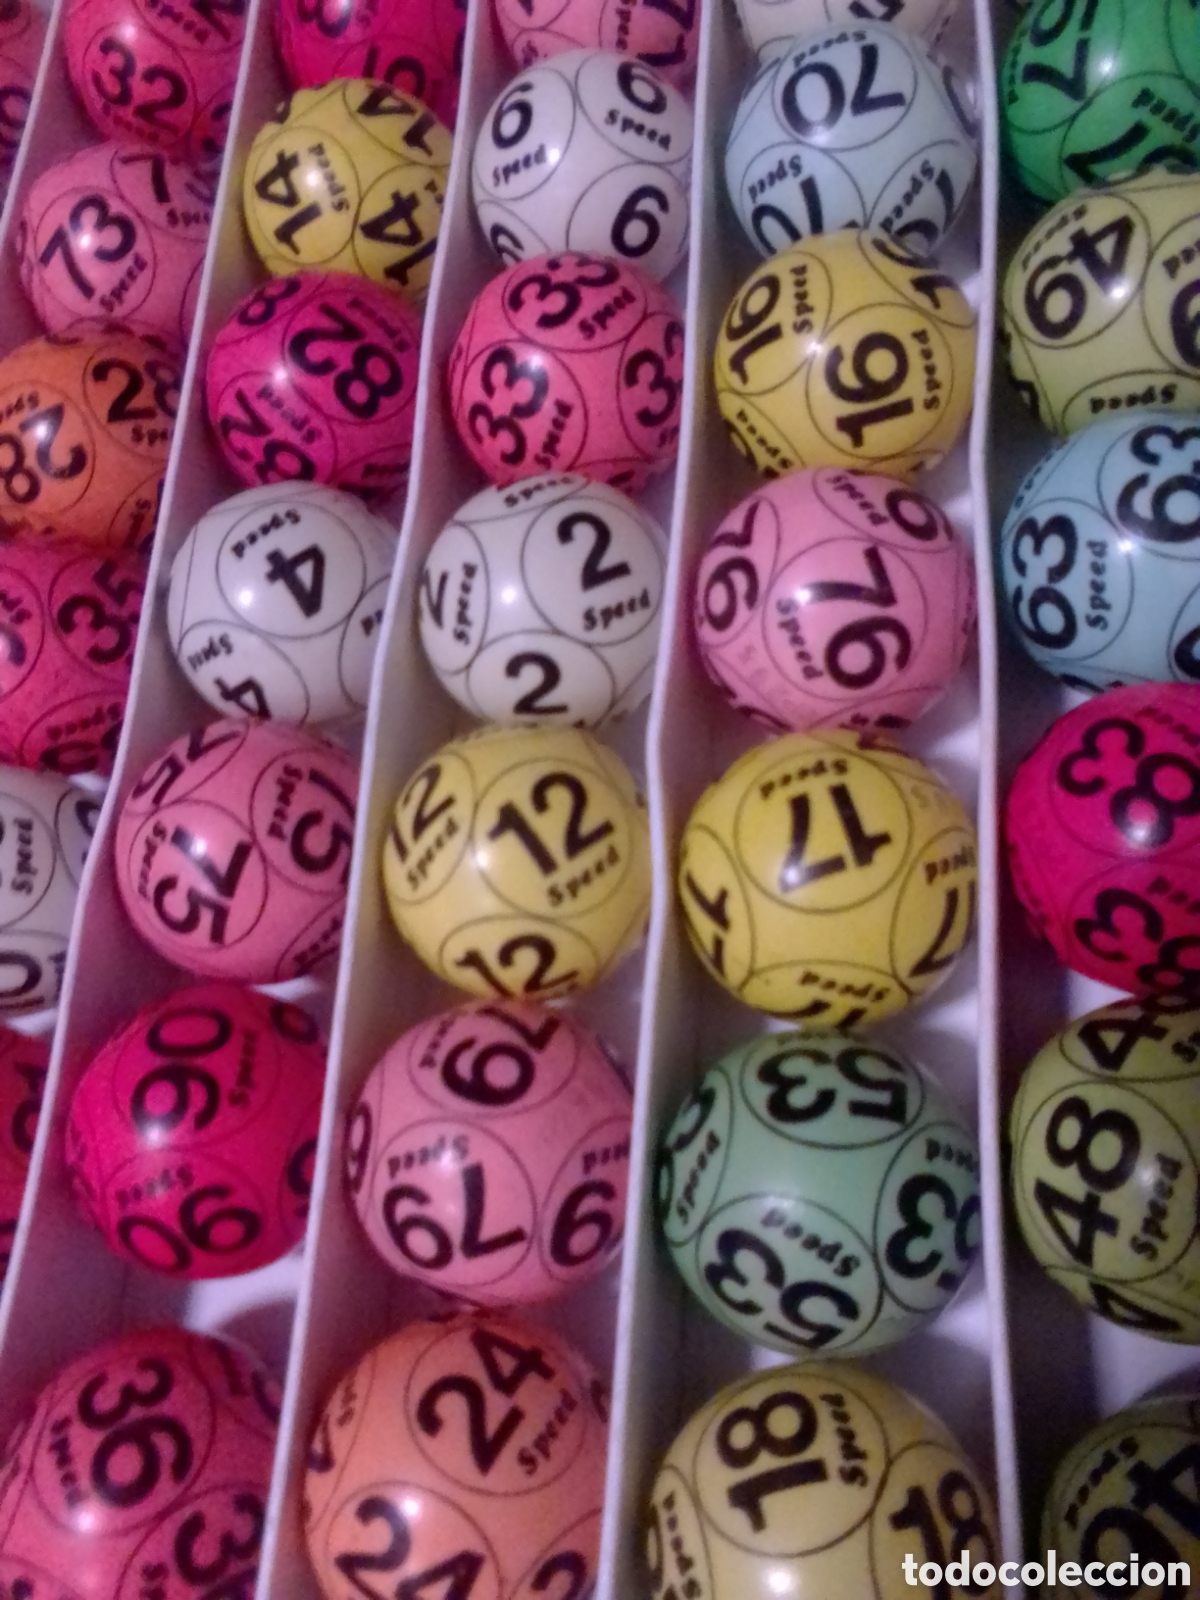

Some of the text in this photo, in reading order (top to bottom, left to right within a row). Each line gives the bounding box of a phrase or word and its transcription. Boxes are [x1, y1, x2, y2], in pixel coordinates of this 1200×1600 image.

[91, 37, 188, 137] 32
[605, 107, 672, 152] Speed
[781, 43, 906, 142] 70
[255, 148, 323, 256] 14
[492, 143, 547, 187] Speed
[747, 154, 804, 204] Speed
[40, 193, 137, 300] 73
[358, 190, 438, 286] 14
[610, 184, 670, 259] 6
[100, 252, 148, 312] Speed
[577, 284, 638, 341] Speed
[791, 263, 815, 334] Speed
[1023, 213, 1136, 340] 49
[290, 303, 404, 421] 82
[725, 276, 784, 386] 16
[911, 328, 943, 410] Speed
[467, 346, 550, 466] 33
[534, 398, 574, 468] Speed
[824, 331, 916, 449] 16
[230, 508, 302, 561] Speed
[265, 545, 326, 620] 4
[557, 511, 632, 593] 2
[1011, 514, 1079, 650] 63
[453, 562, 478, 646] Speed
[583, 587, 651, 633] Speed
[800, 545, 912, 690] 76
[1085, 540, 1112, 632] Speed
[505, 652, 569, 716] 2
[486, 771, 616, 876] 12
[1056, 717, 1200, 850] 83
[153, 824, 253, 945] 75
[546, 843, 621, 907] Speed
[777, 782, 894, 893] 17
[455, 933, 580, 1000] 12
[130, 998, 233, 1134] 90
[756, 1046, 908, 1124] 53
[117, 1184, 262, 1272] 90
[383, 1162, 526, 1270] 79
[1033, 1094, 1142, 1268] 48
[703, 1227, 860, 1351] 53
[759, 1206, 860, 1278] Speed
[77, 1356, 195, 1508] 36
[417, 1327, 557, 1478] 24
[516, 1386, 579, 1477] Speed
[819, 1392, 869, 1488] Speed
[716, 1391, 829, 1534] 18
